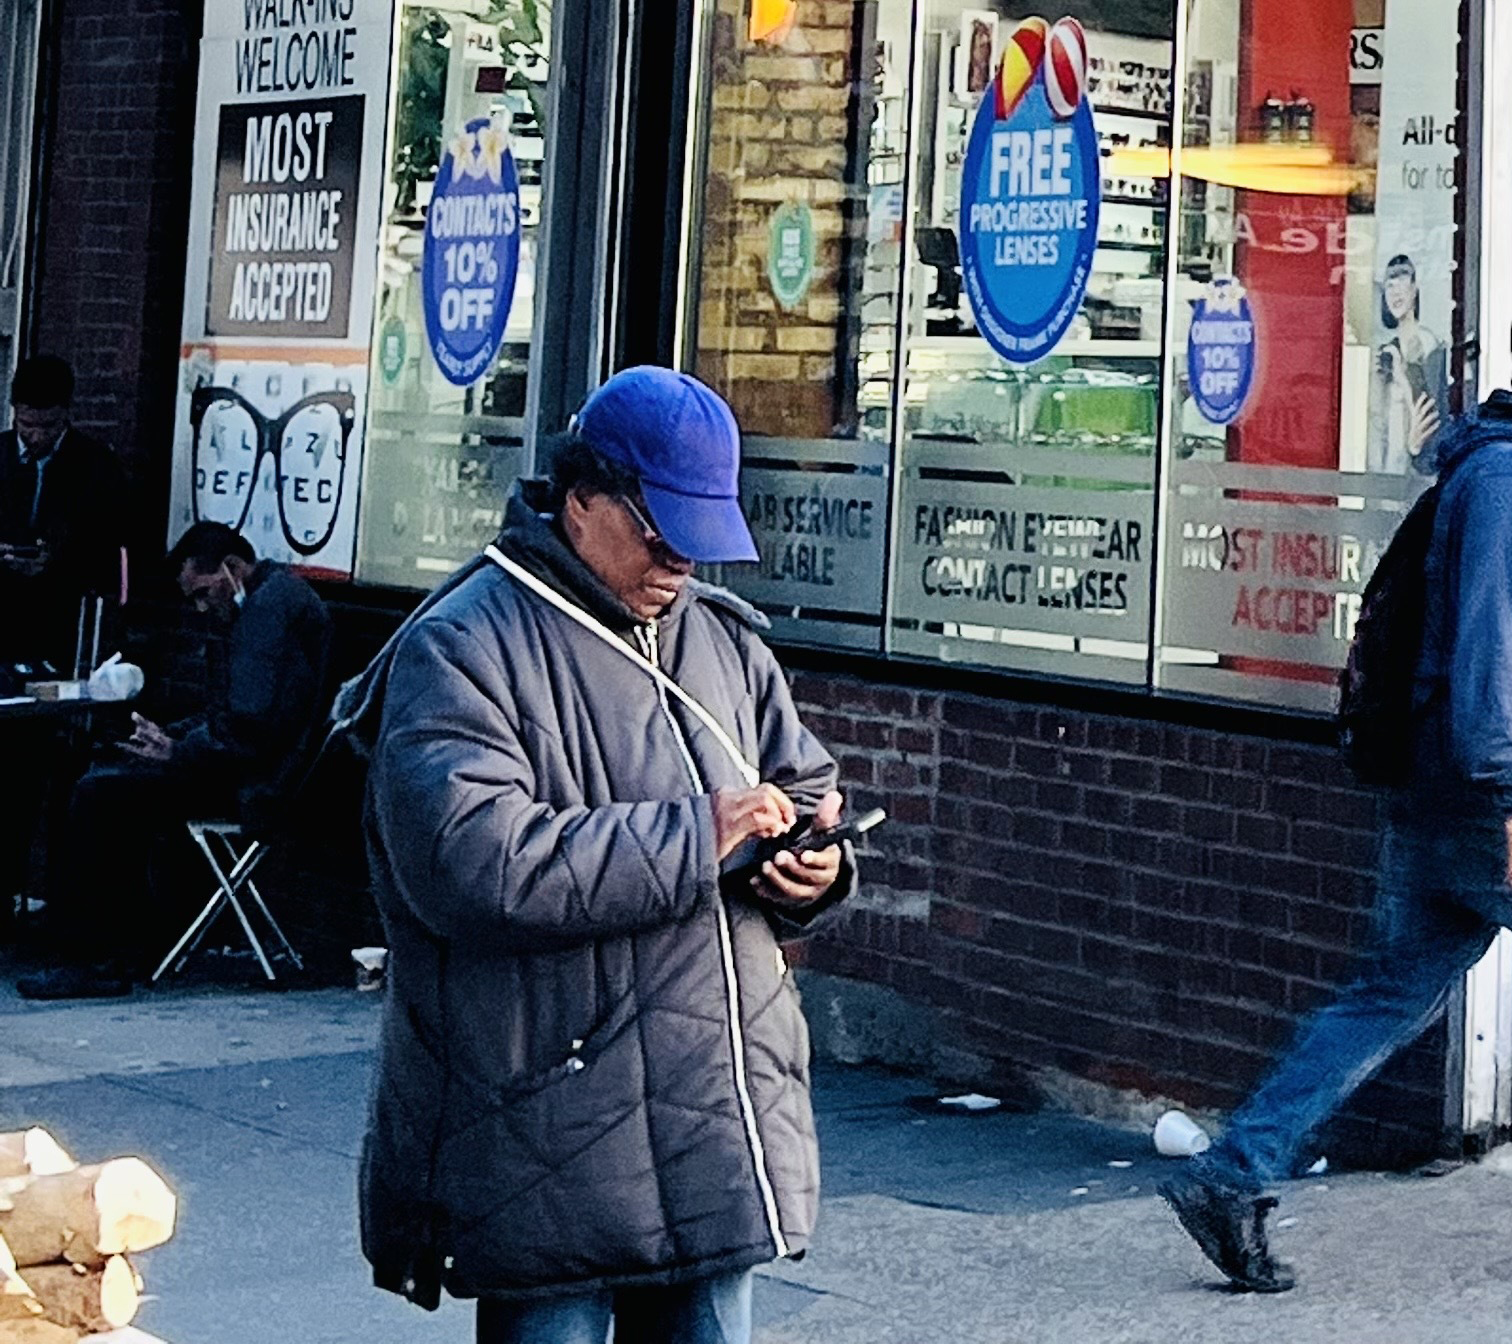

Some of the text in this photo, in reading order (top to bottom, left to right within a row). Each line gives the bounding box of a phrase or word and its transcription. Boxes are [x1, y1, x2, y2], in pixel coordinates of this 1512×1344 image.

[235, 26, 358, 94] WELCOME
[242, 111, 334, 184] MOST
[988, 128, 1075, 199] FREE
[1400, 160, 1429, 190] for
[225, 189, 343, 252] INSURANCE
[430, 192, 517, 239] CONTACTS
[969, 199, 1089, 234] PROGRESSIVE
[443, 241, 499, 285] 10%
[993, 236, 1060, 267] LENSES
[228, 261, 333, 323] ACCEPTED
[438, 288, 497, 332] OFF
[1199, 369, 1240, 396] OFF
[748, 492, 874, 540] AB SERVICE
[914, 503, 1142, 562] FASHION EYEWEAR
[1181, 521, 1264, 573] MOST
[921, 554, 1128, 610] CONTACT LENSES
